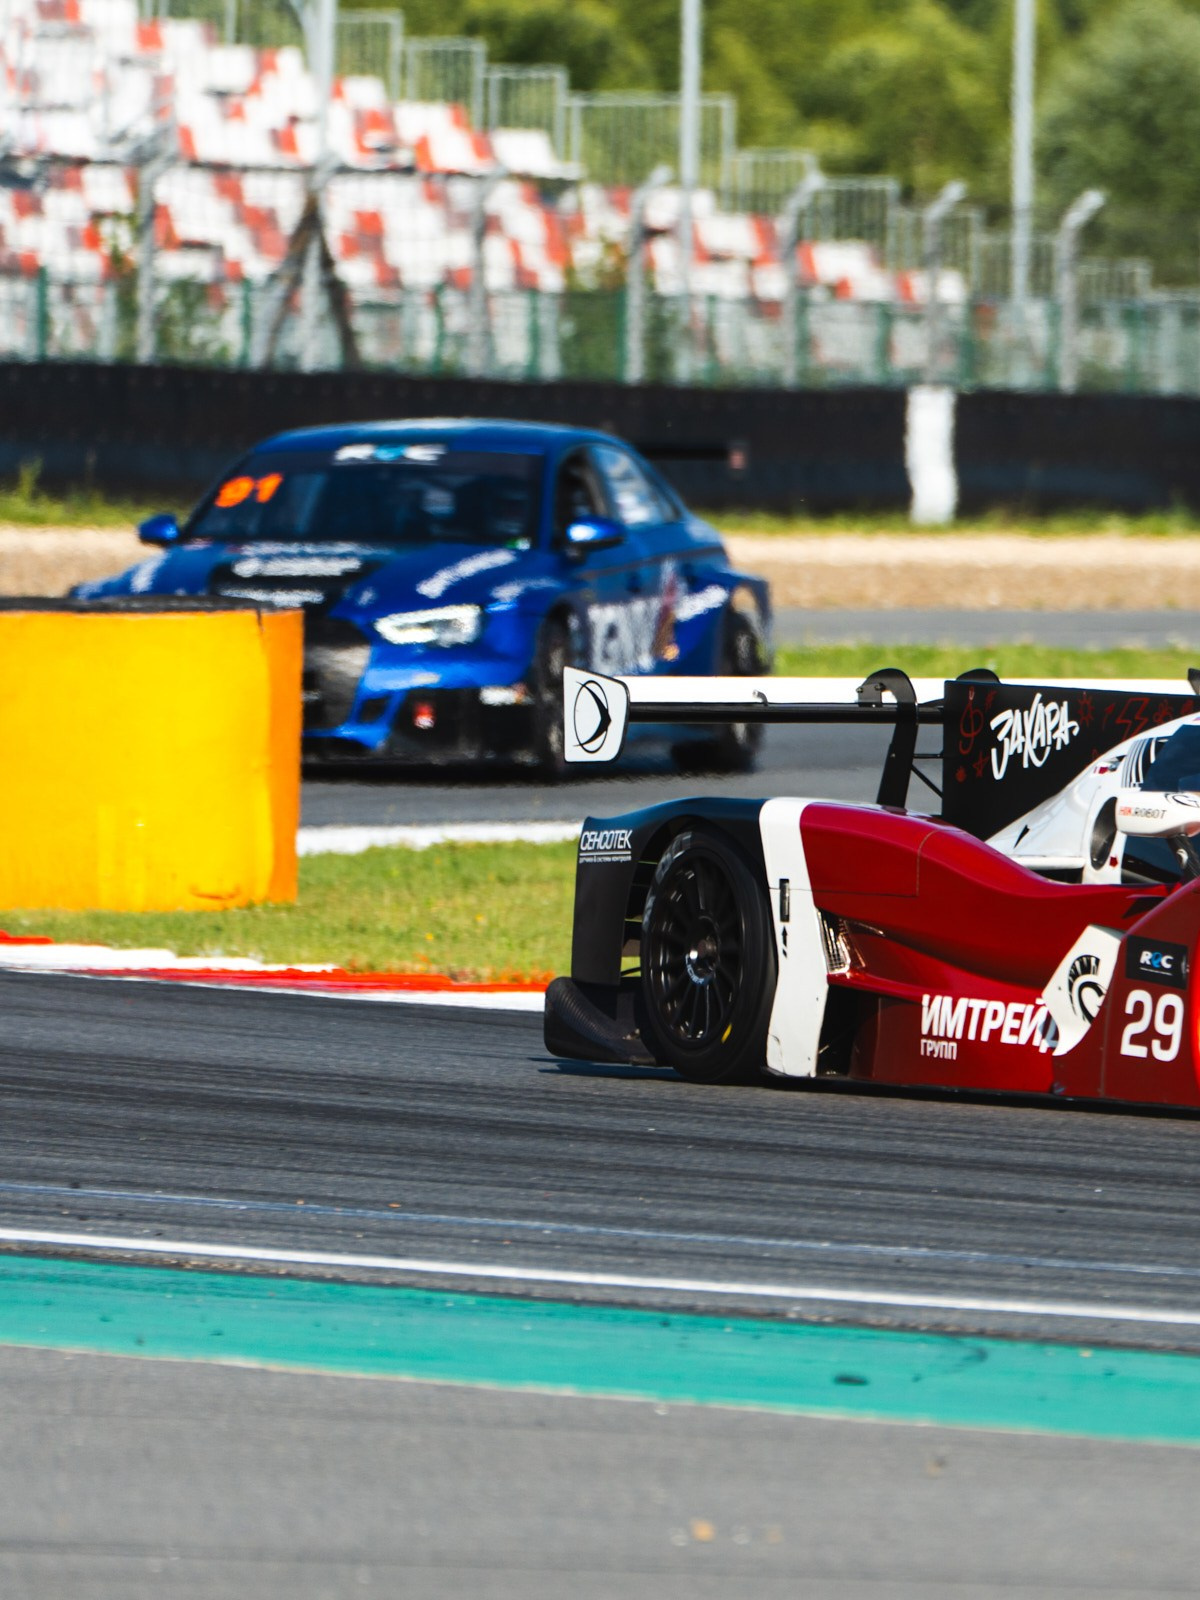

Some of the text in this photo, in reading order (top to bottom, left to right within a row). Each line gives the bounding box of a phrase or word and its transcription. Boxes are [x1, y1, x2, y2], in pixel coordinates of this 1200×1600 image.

[215, 473, 284, 508] 91
[580, 829, 633, 850] СЕНСОТЕК
[1120, 989, 1184, 1062] 29
[920, 1038, 957, 1060] ГРУПП
